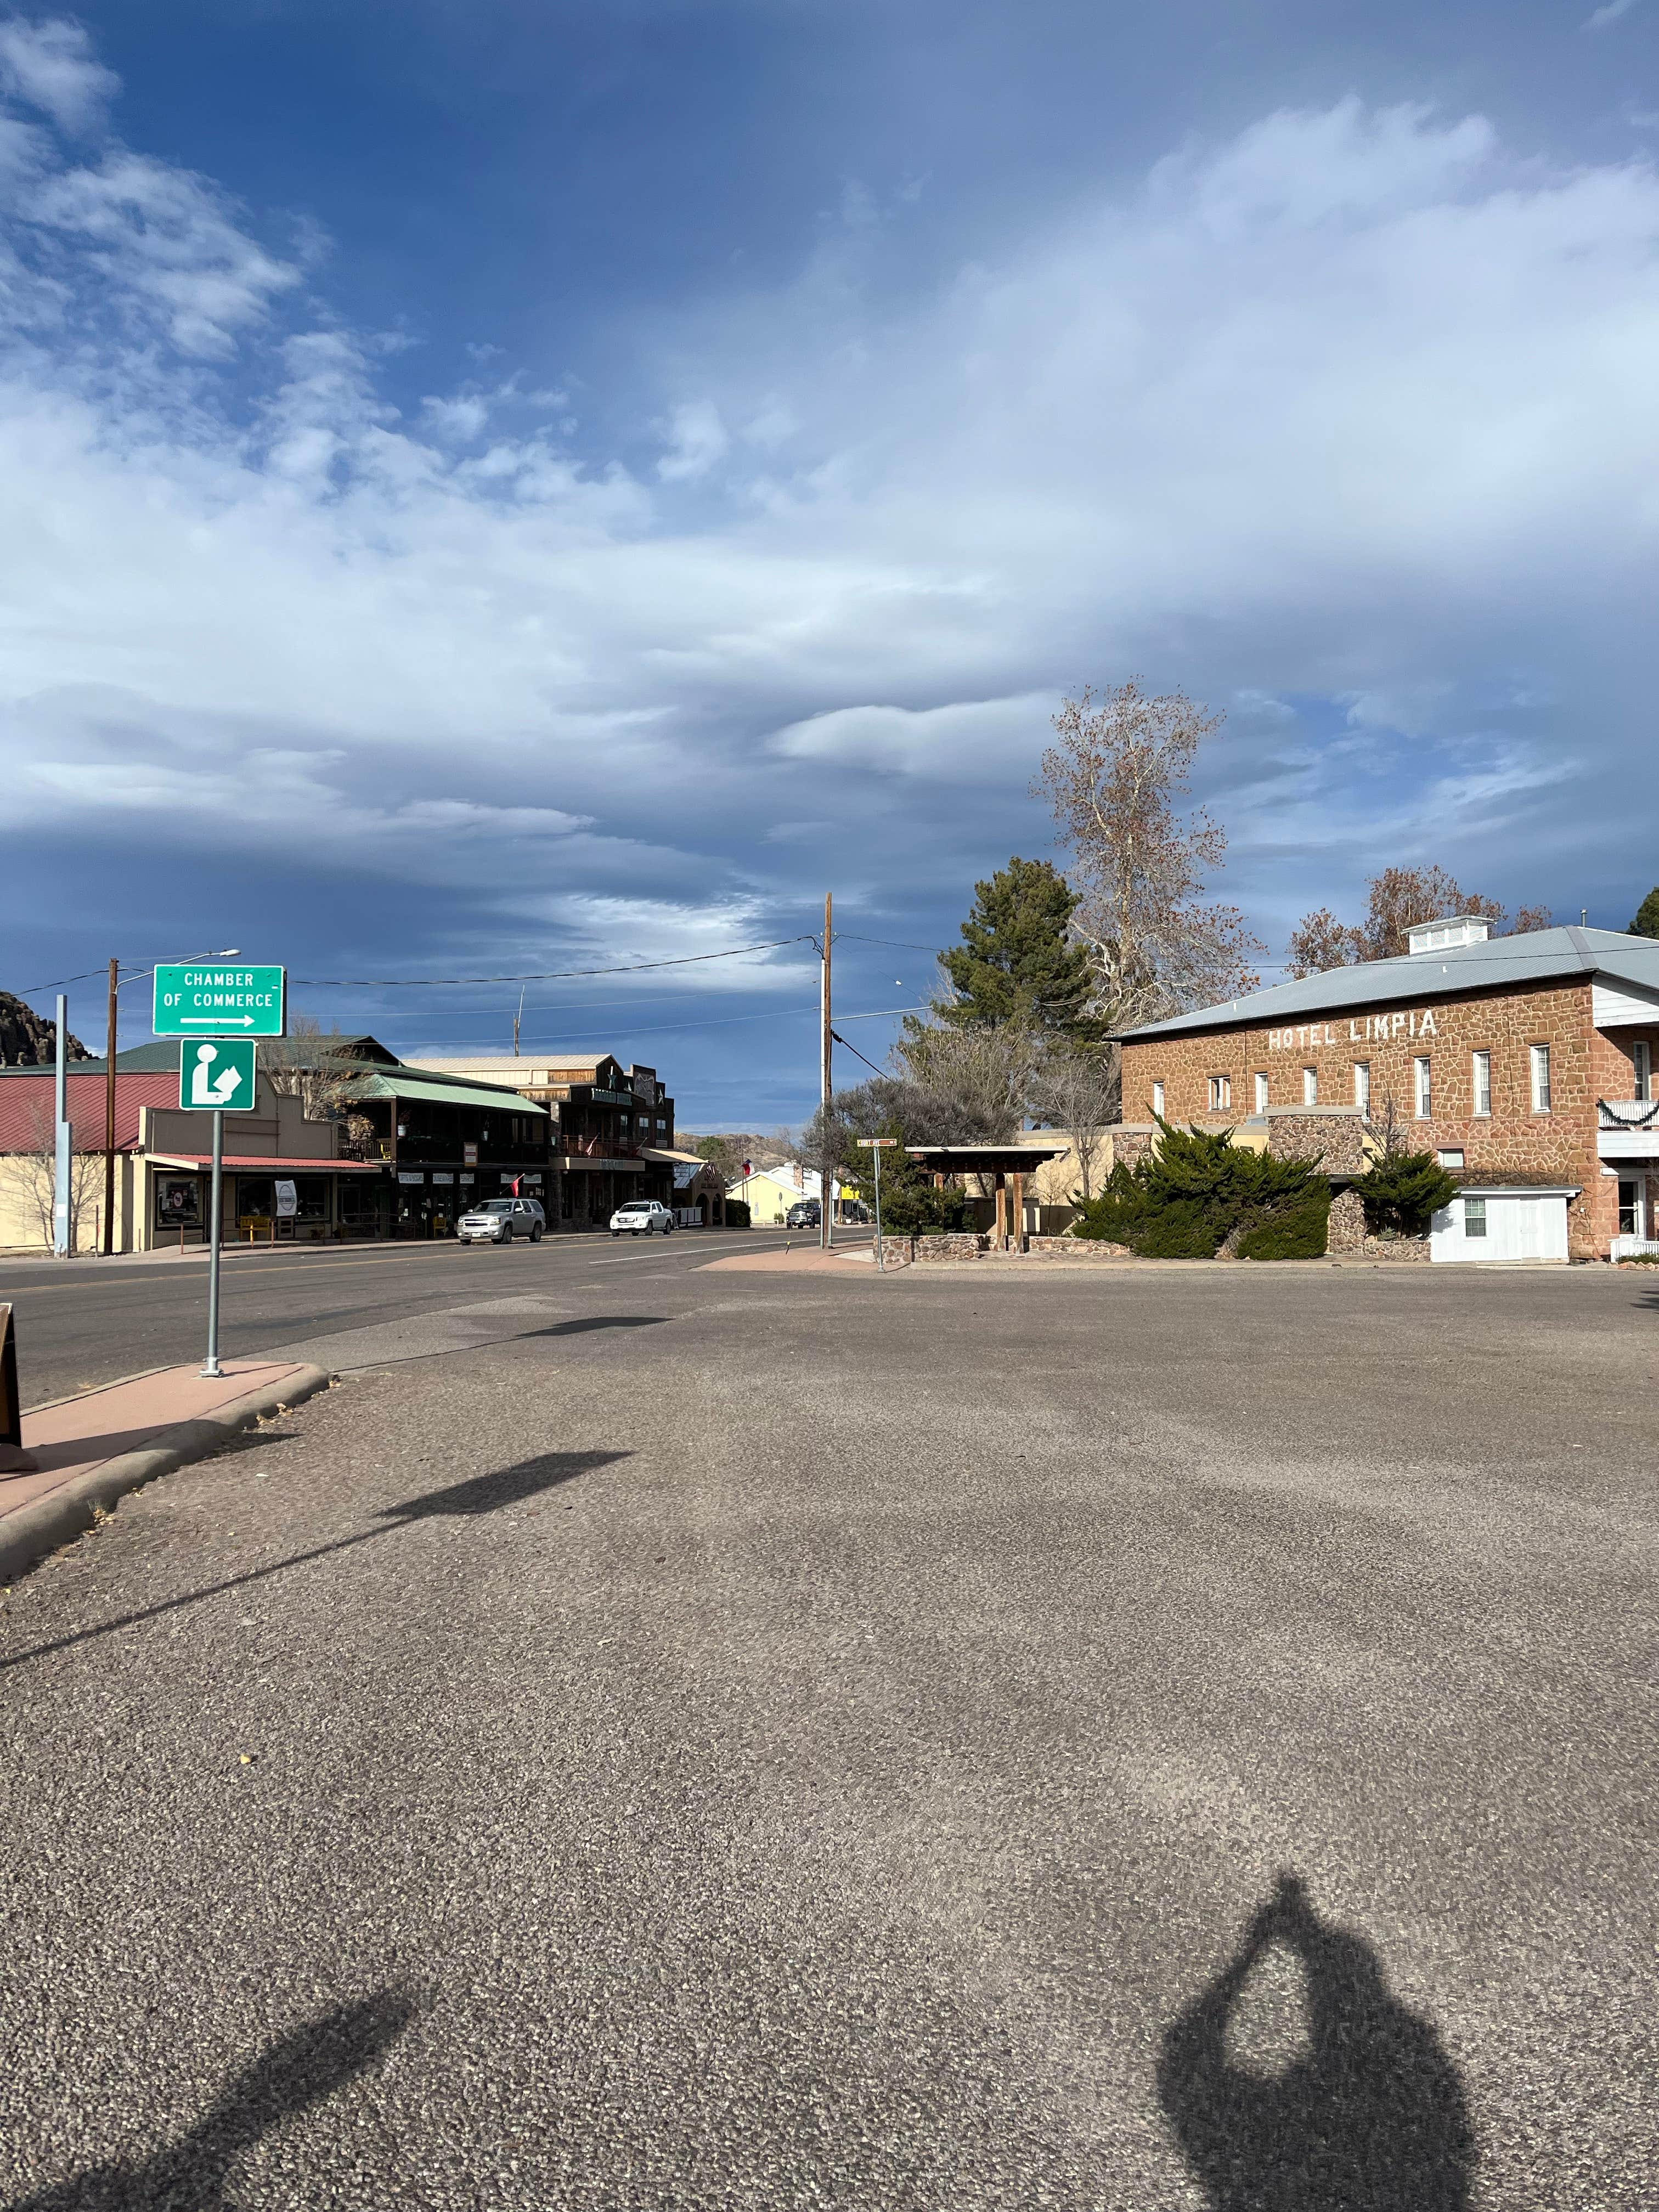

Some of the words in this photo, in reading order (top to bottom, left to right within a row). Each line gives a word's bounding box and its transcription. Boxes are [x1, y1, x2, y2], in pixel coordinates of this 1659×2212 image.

[184, 973, 253, 986] CHAMBER
[163, 993, 182, 1006] OF
[194, 994, 273, 1007] COMMERCE
[1268, 1024, 1336, 1049] HOTEL
[1350, 1009, 1437, 1041] LIMPIA
